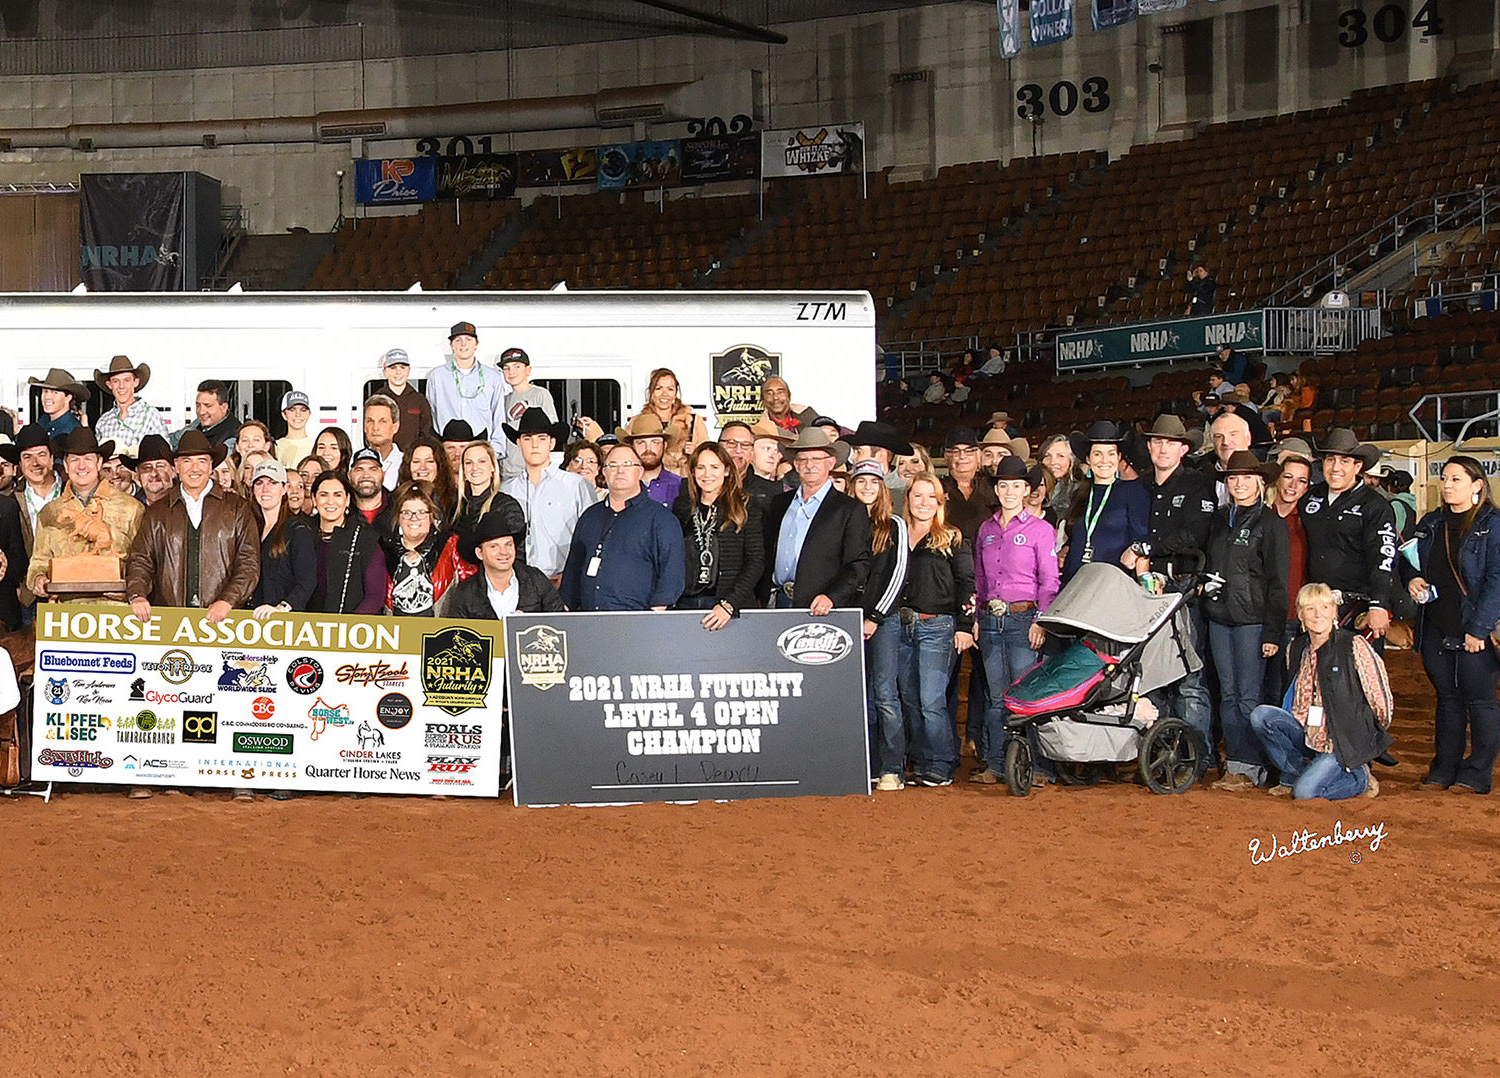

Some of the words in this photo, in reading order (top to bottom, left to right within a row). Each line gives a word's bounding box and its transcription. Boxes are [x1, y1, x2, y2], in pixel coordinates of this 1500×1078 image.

[1338, 2, 1444, 48] 304
[1016, 76, 1111, 121] 303
[381, 159, 415, 184] KP
[82, 245, 157, 267] NRHA
[796, 302, 847, 321] ZTM
[1205, 321, 1248, 345] NRHA
[1059, 338, 1095, 361] NRHA
[1130, 331, 1170, 353] NRHA
[715, 385, 762, 401] NRH
[43, 610, 162, 642] HORSE
[171, 616, 401, 651] ASSOCIATION
[44, 655, 101, 668] Bluebonnet
[102, 657, 133, 669] Feeds
[141, 662, 171, 671] TETON
[287, 658, 323, 675] COLSTON
[427, 657, 453, 666] 2021
[520, 654, 565, 666] NRHA
[426, 666, 486, 681] NRHA
[433, 678, 478, 694] Futurity
[569, 675, 623, 701] 2021
[630, 674, 695, 699] NRHA
[699, 673, 804, 699] FUTURITY
[145, 690, 213, 705] GlycoGuard
[312, 709, 341, 717] HORSE
[603, 702, 684, 728] LEVEL
[690, 701, 707, 727] 4
[713, 700, 779, 726] OPEN
[424, 723, 482, 734] FOALS
[116, 730, 152, 744] TAMARACK
[152, 731, 175, 745] RANCH
[237, 735, 289, 747] OSWOOD
[627, 728, 761, 756] CHAMPION
[339, 749, 374, 759] CINDER
[375, 751, 402, 760] LAKES
[142, 759, 168, 768] ACS
[198, 758, 297, 769] INTERNATIONAL
[427, 763, 477, 773] RUF
[305, 764, 351, 779] Quarter
[353, 766, 387, 779] Horse
[389, 767, 421, 781] News
[615, 760, 664, 787] Casey
